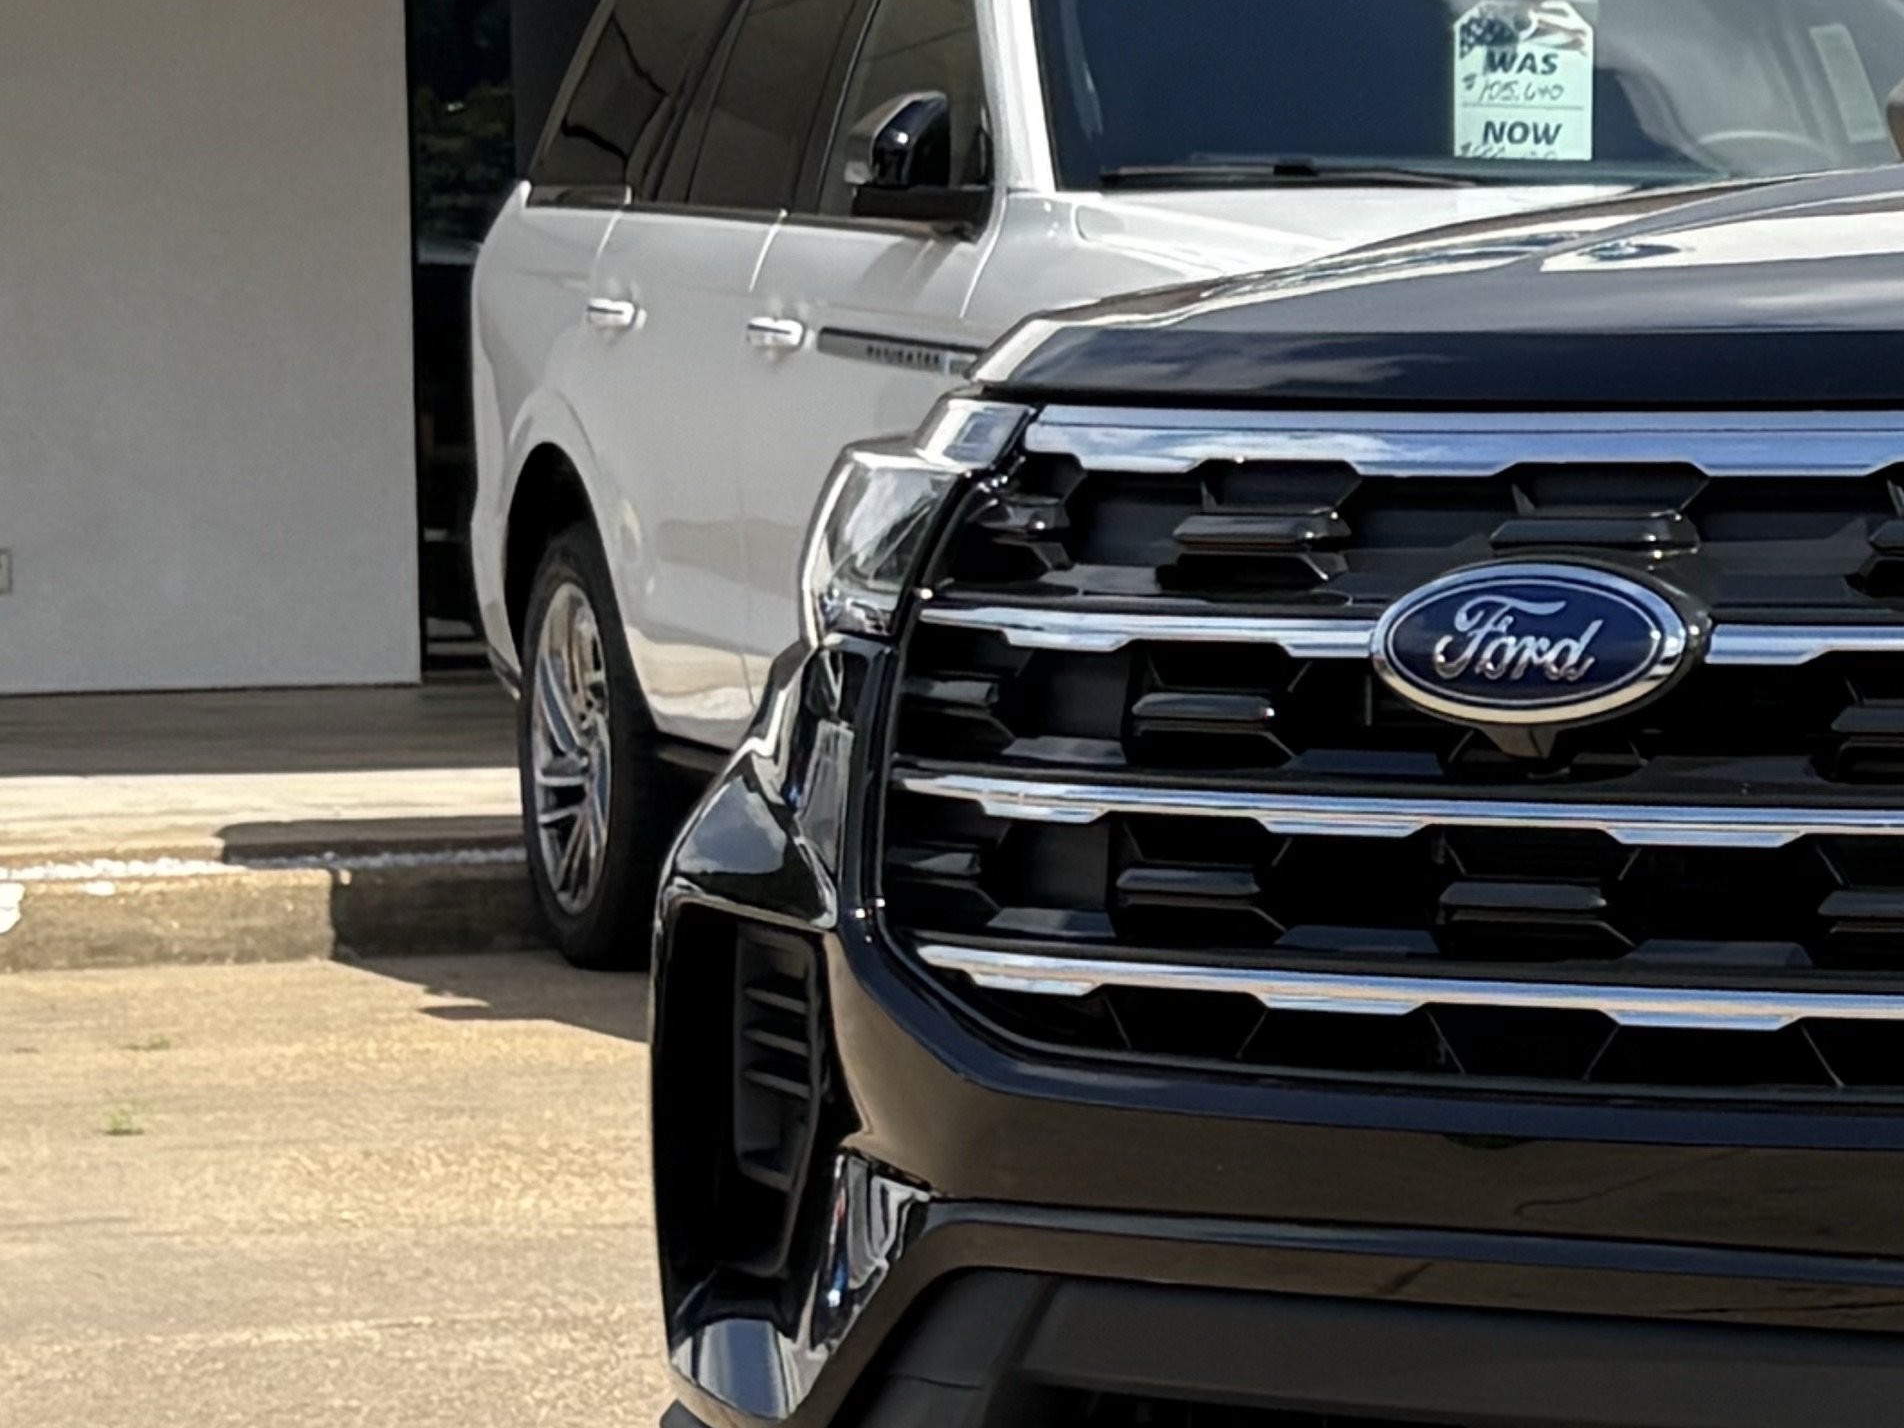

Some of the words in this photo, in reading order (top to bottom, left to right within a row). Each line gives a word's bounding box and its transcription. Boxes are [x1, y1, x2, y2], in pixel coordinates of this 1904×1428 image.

[1484, 50, 1559, 74] WAS
[1481, 120, 1562, 146] NOW
[1434, 594, 1603, 682] Ford
